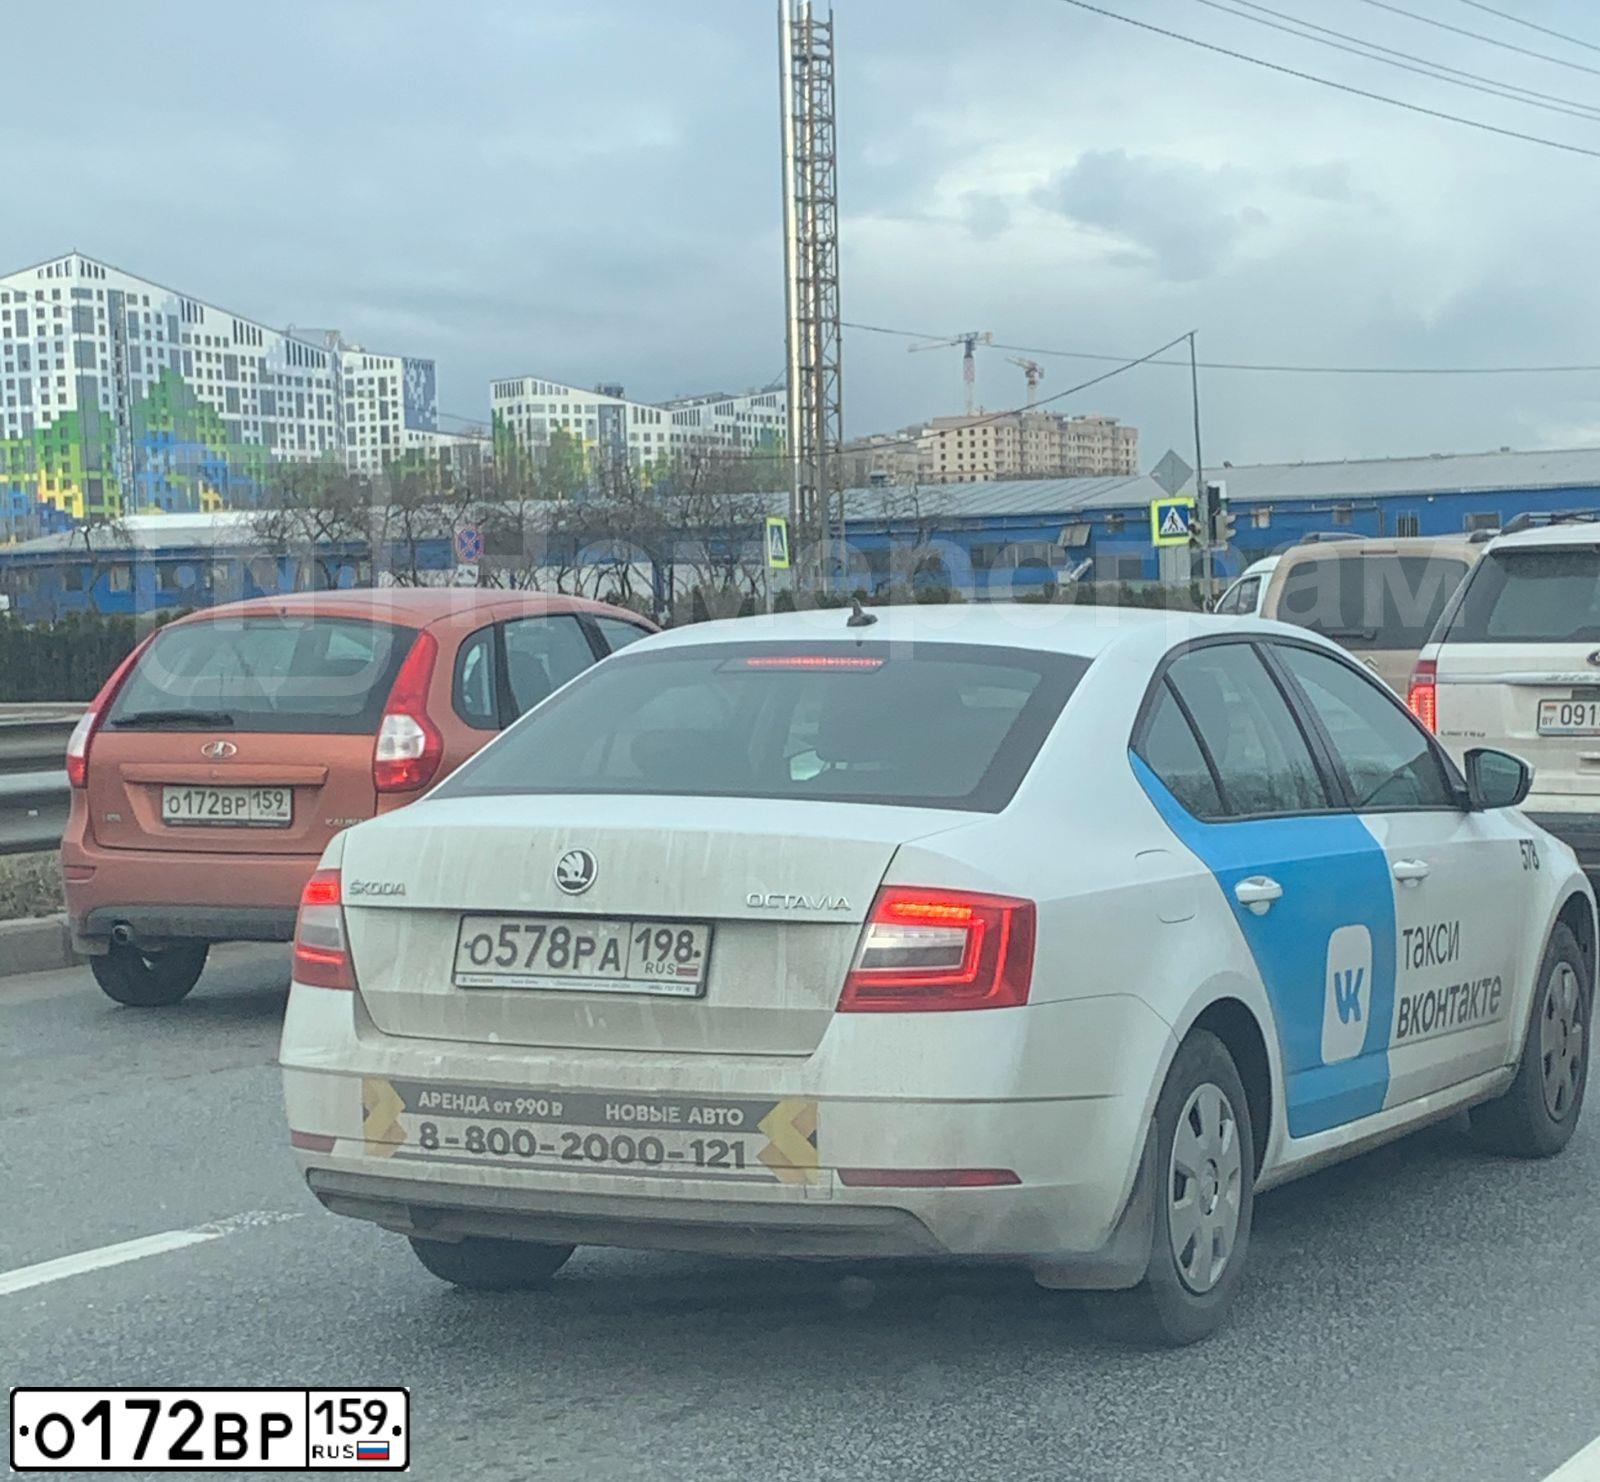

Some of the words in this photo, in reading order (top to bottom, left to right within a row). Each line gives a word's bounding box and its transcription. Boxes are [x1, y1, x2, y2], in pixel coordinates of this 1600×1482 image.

[1561, 704, 1600, 726] 091
[252, 790, 284, 810] 159
[1519, 839, 1540, 871] 578
[746, 893, 852, 912] OCTAVIA
[634, 927, 694, 963] 198
[644, 962, 676, 975] RUS
[418, 1091, 490, 1114] АРЕНДА
[493, 1101, 512, 1114] от
[514, 1098, 549, 1117] 990
[605, 1103, 681, 1123] НОВЫЕ
[688, 1107, 744, 1126] АВТО
[419, 1121, 746, 1169] 8-800-2000-121
